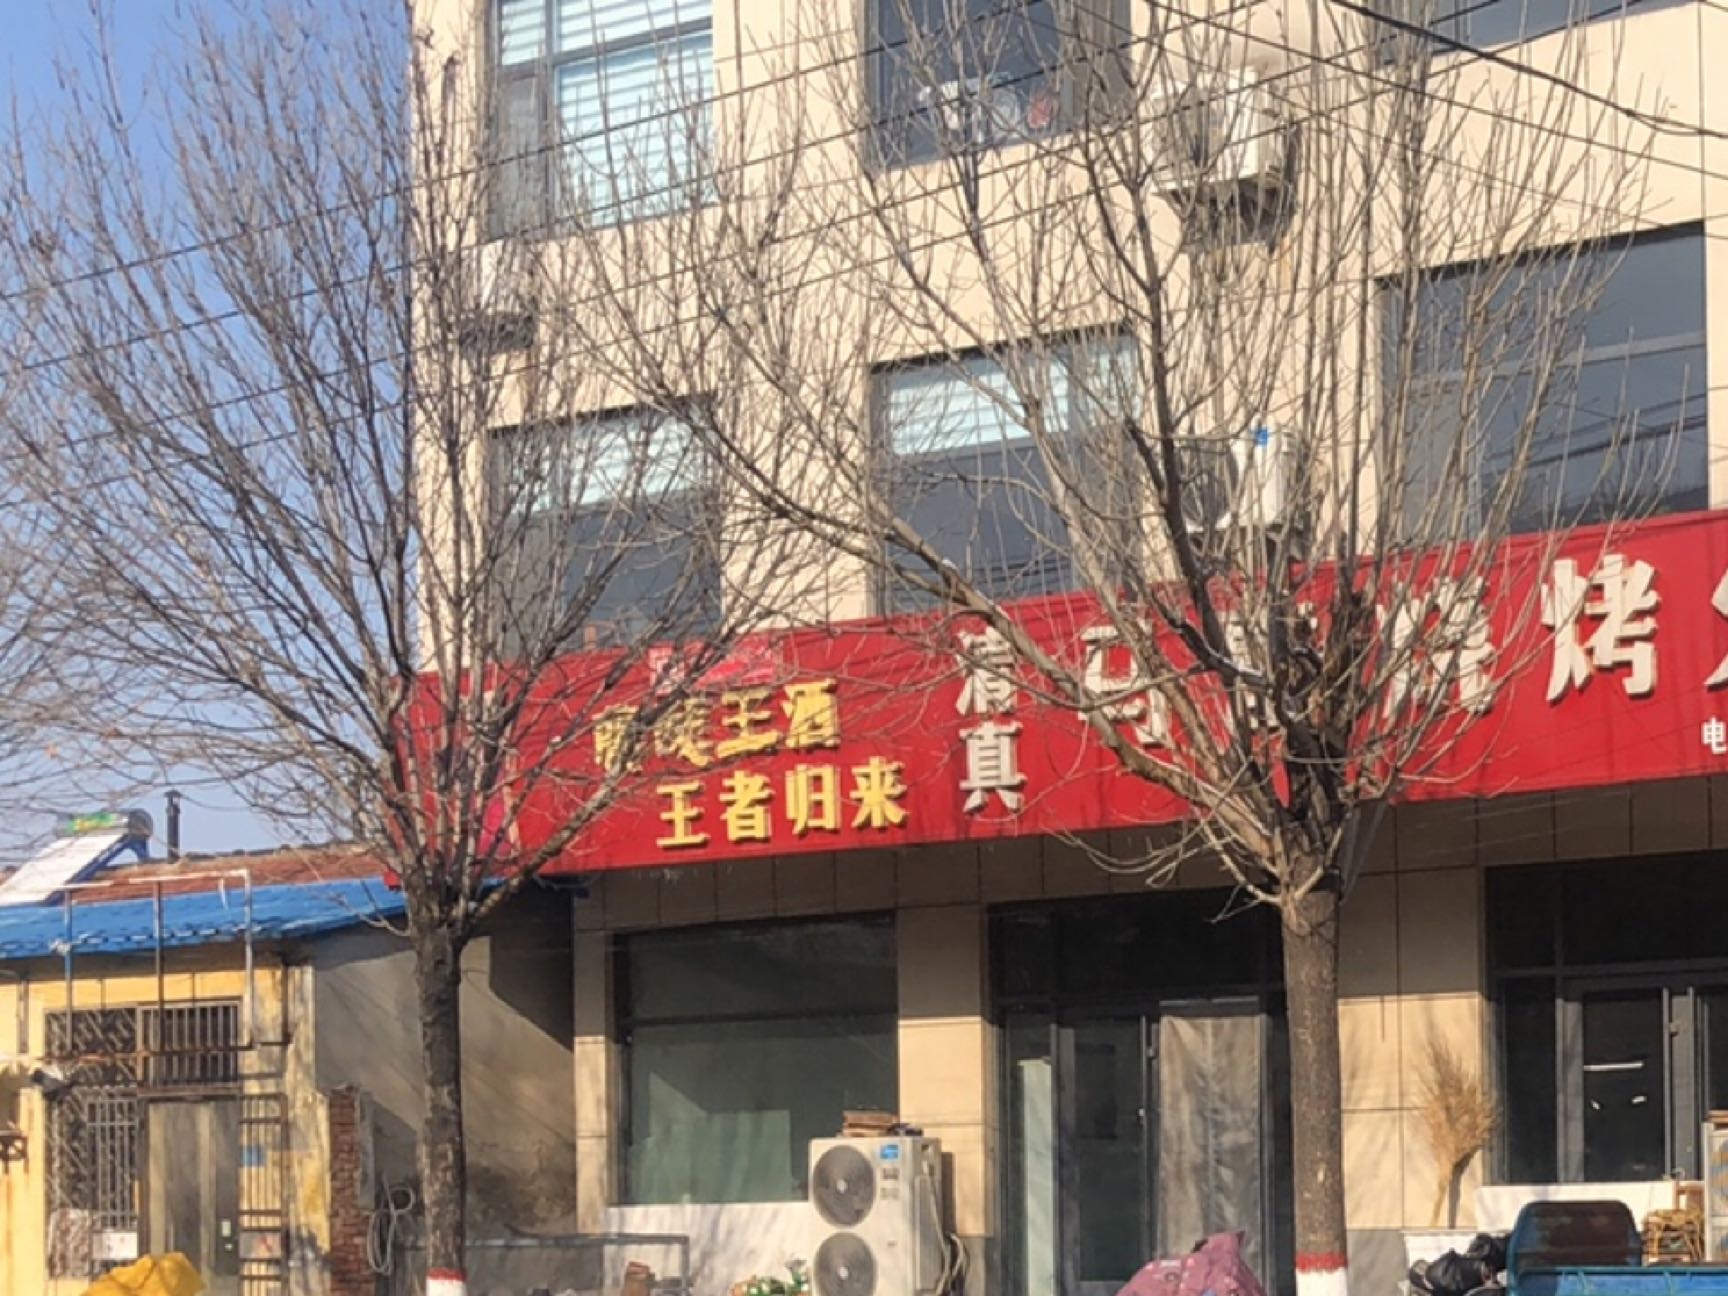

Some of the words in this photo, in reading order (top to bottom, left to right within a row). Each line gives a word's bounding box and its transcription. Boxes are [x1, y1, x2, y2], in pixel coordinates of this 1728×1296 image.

[955, 626, 1027, 814] 清真
[656, 756, 909, 848] 王者归来
